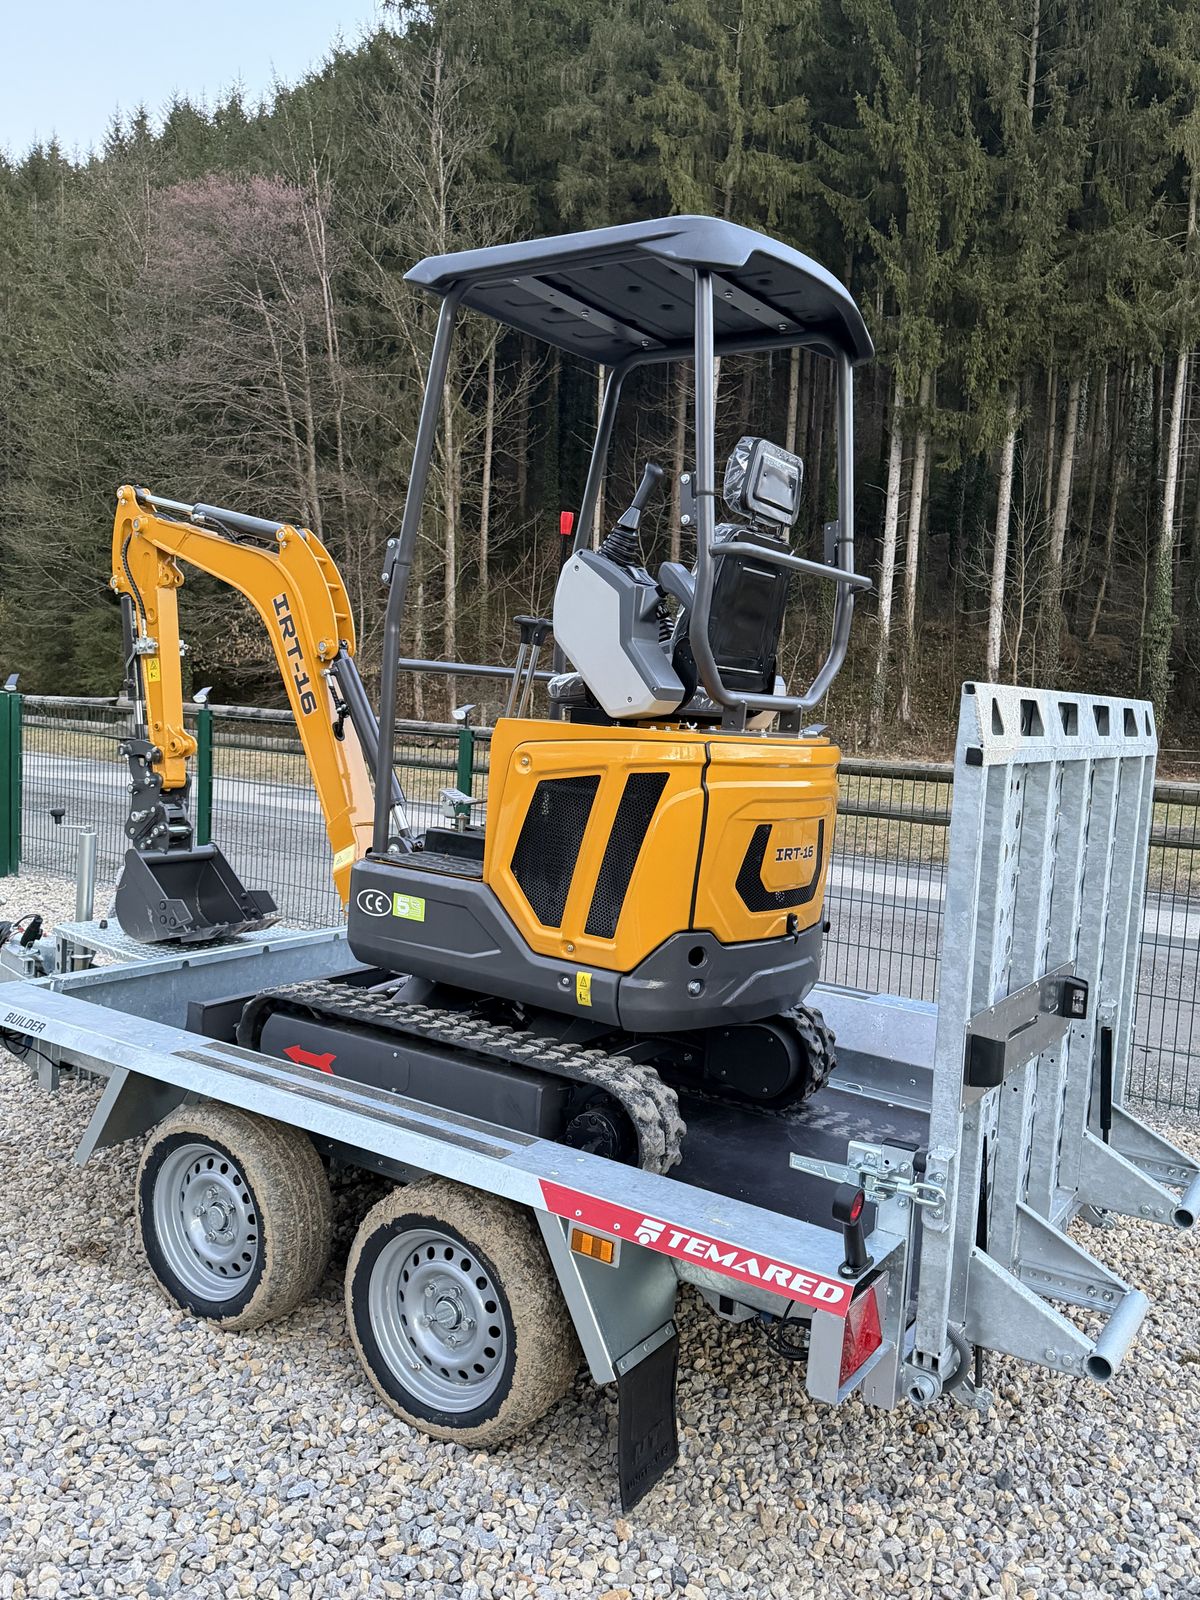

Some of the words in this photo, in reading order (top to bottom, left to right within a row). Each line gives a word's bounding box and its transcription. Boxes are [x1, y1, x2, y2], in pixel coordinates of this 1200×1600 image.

[273, 593, 317, 715] IRT-16
[775, 845, 813, 861] IRT-16
[4, 1012, 46, 1033] BUILDER
[668, 1229, 844, 1303] TEMARED
